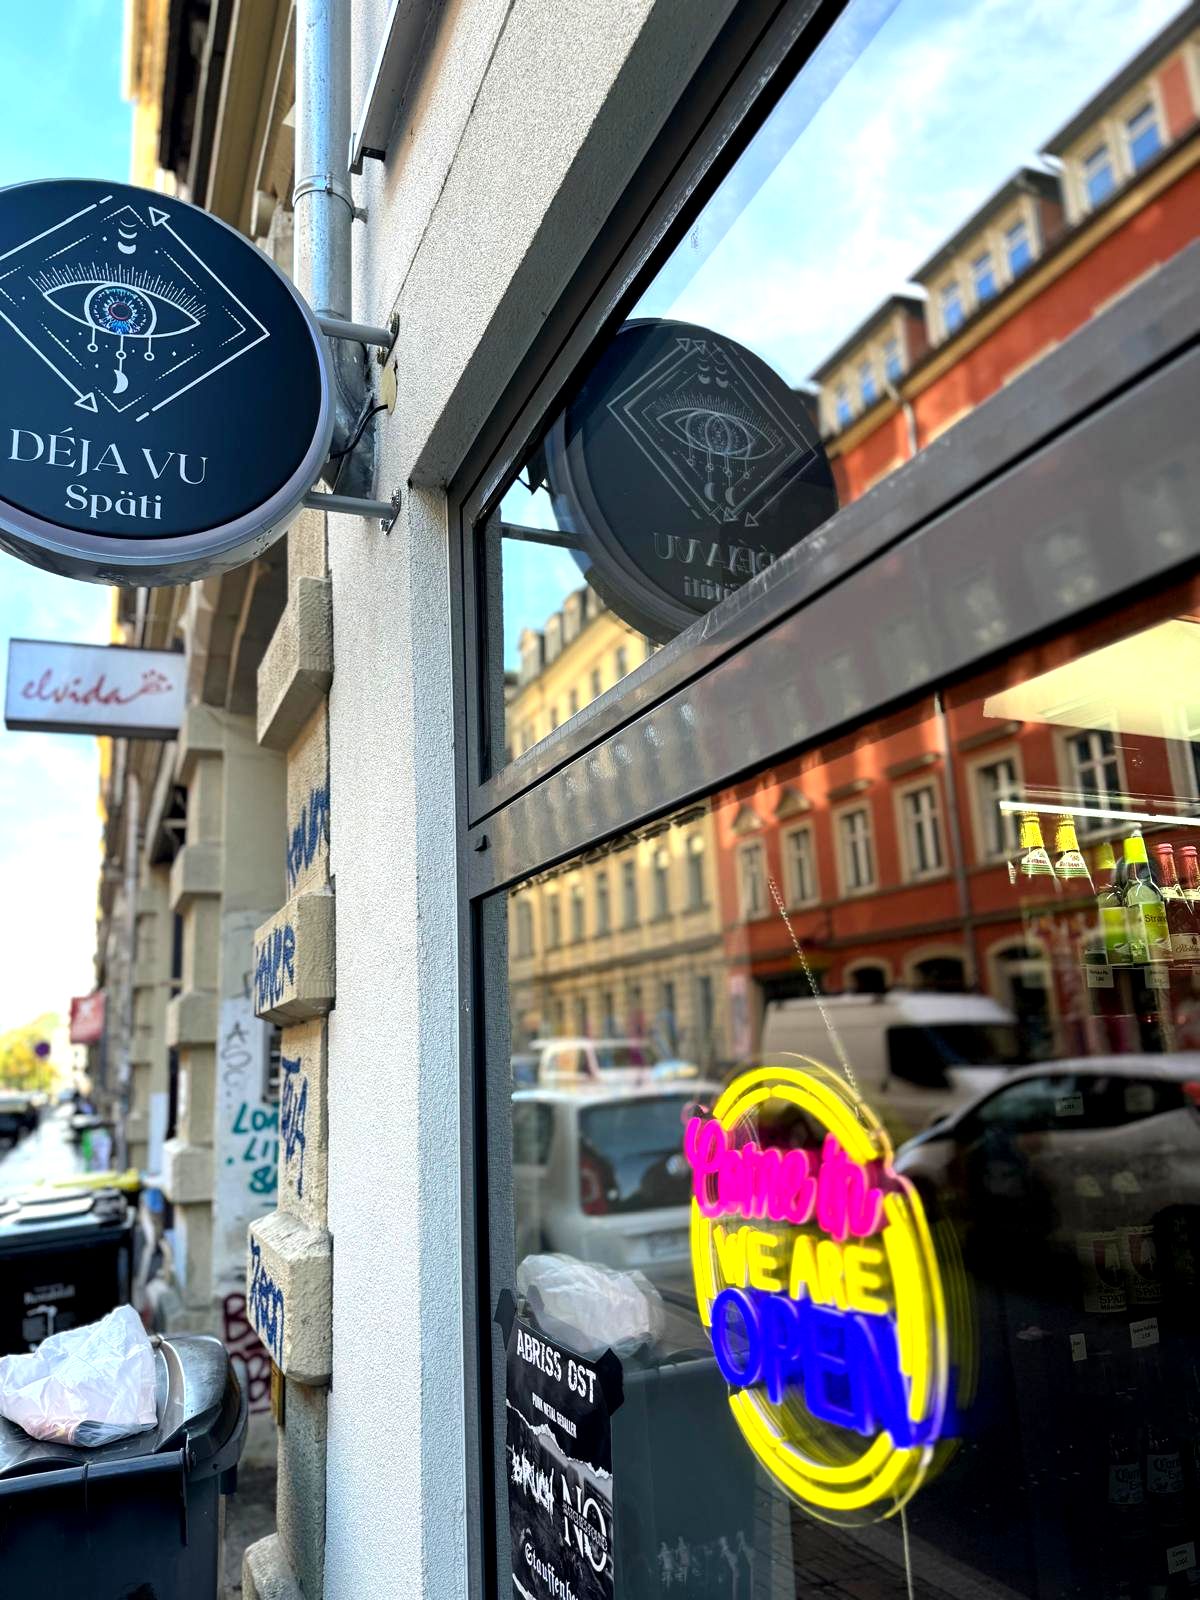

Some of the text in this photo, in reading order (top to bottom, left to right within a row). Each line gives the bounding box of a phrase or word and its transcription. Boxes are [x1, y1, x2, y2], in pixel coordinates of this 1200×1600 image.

[8, 426, 208, 486] DÉJA VU
[64, 483, 162, 519] Späti
[684, 1116, 816, 1225] Come
[713, 1224, 889, 1316] WE ARE
[516, 1328, 597, 1404] ABRISS OST
[711, 1286, 917, 1449] OPEN
